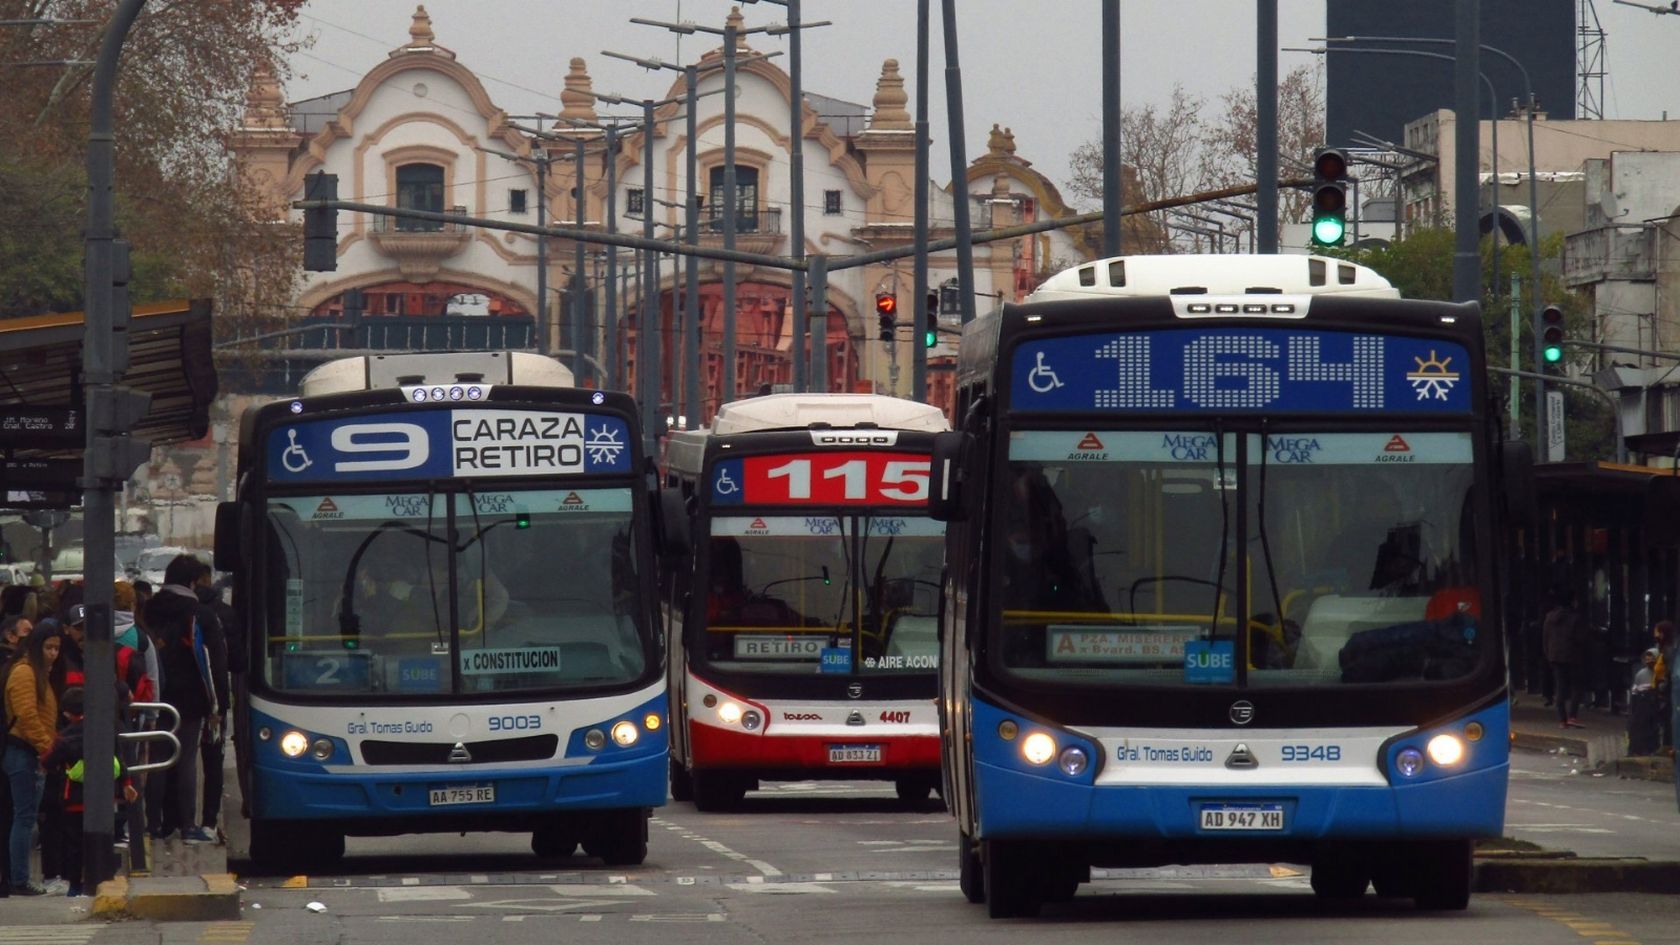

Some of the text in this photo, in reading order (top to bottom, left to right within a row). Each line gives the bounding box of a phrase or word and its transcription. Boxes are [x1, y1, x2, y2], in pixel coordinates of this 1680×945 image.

[1095, 336, 1384, 408] 164
[453, 416, 584, 442] CARAZA
[331, 422, 430, 472] 9
[1162, 434, 1217, 451] MEGA
[1266, 436, 1321, 453] MEGA
[455, 444, 582, 470] RETIRO
[1067, 452, 1109, 461] AGRALE
[1171, 446, 1209, 461] CAR
[1275, 449, 1314, 464] CAR
[1375, 454, 1416, 463] AGRALE
[768, 459, 931, 501] 115
[385, 495, 430, 508] MEGA
[473, 494, 514, 505] MEGA
[392, 505, 423, 517] CAR
[478, 503, 509, 514] CAR
[558, 503, 590, 512] AGRALE
[311, 511, 344, 520] AGRALE
[805, 518, 840, 528] MEGA
[871, 518, 906, 528] MEGA
[810, 526, 833, 535] CAR
[878, 526, 902, 536] CAR
[746, 642, 818, 654] RETIRO
[1057, 633, 1076, 653] A
[1118, 634, 1191, 644] MISERERE
[464, 649, 559, 671] x CONSTITUCION
[822, 655, 849, 665] SUBE
[878, 655, 938, 669] AIRE ACON
[1186, 653, 1231, 668] SUBE
[315, 657, 341, 684] 2
[402, 665, 436, 681] SUBE
[488, 715, 542, 731] 9003
[880, 711, 911, 724] 4407
[347, 720, 433, 735] Gral. Tomas Guido
[846, 750, 864, 761] 833
[1117, 745, 1213, 762] Gral. Tomas Guido
[1281, 745, 1341, 762] 9348
[432, 788, 492, 804] AA 755 RE
[1205, 811, 1280, 827] AD 947 XH
